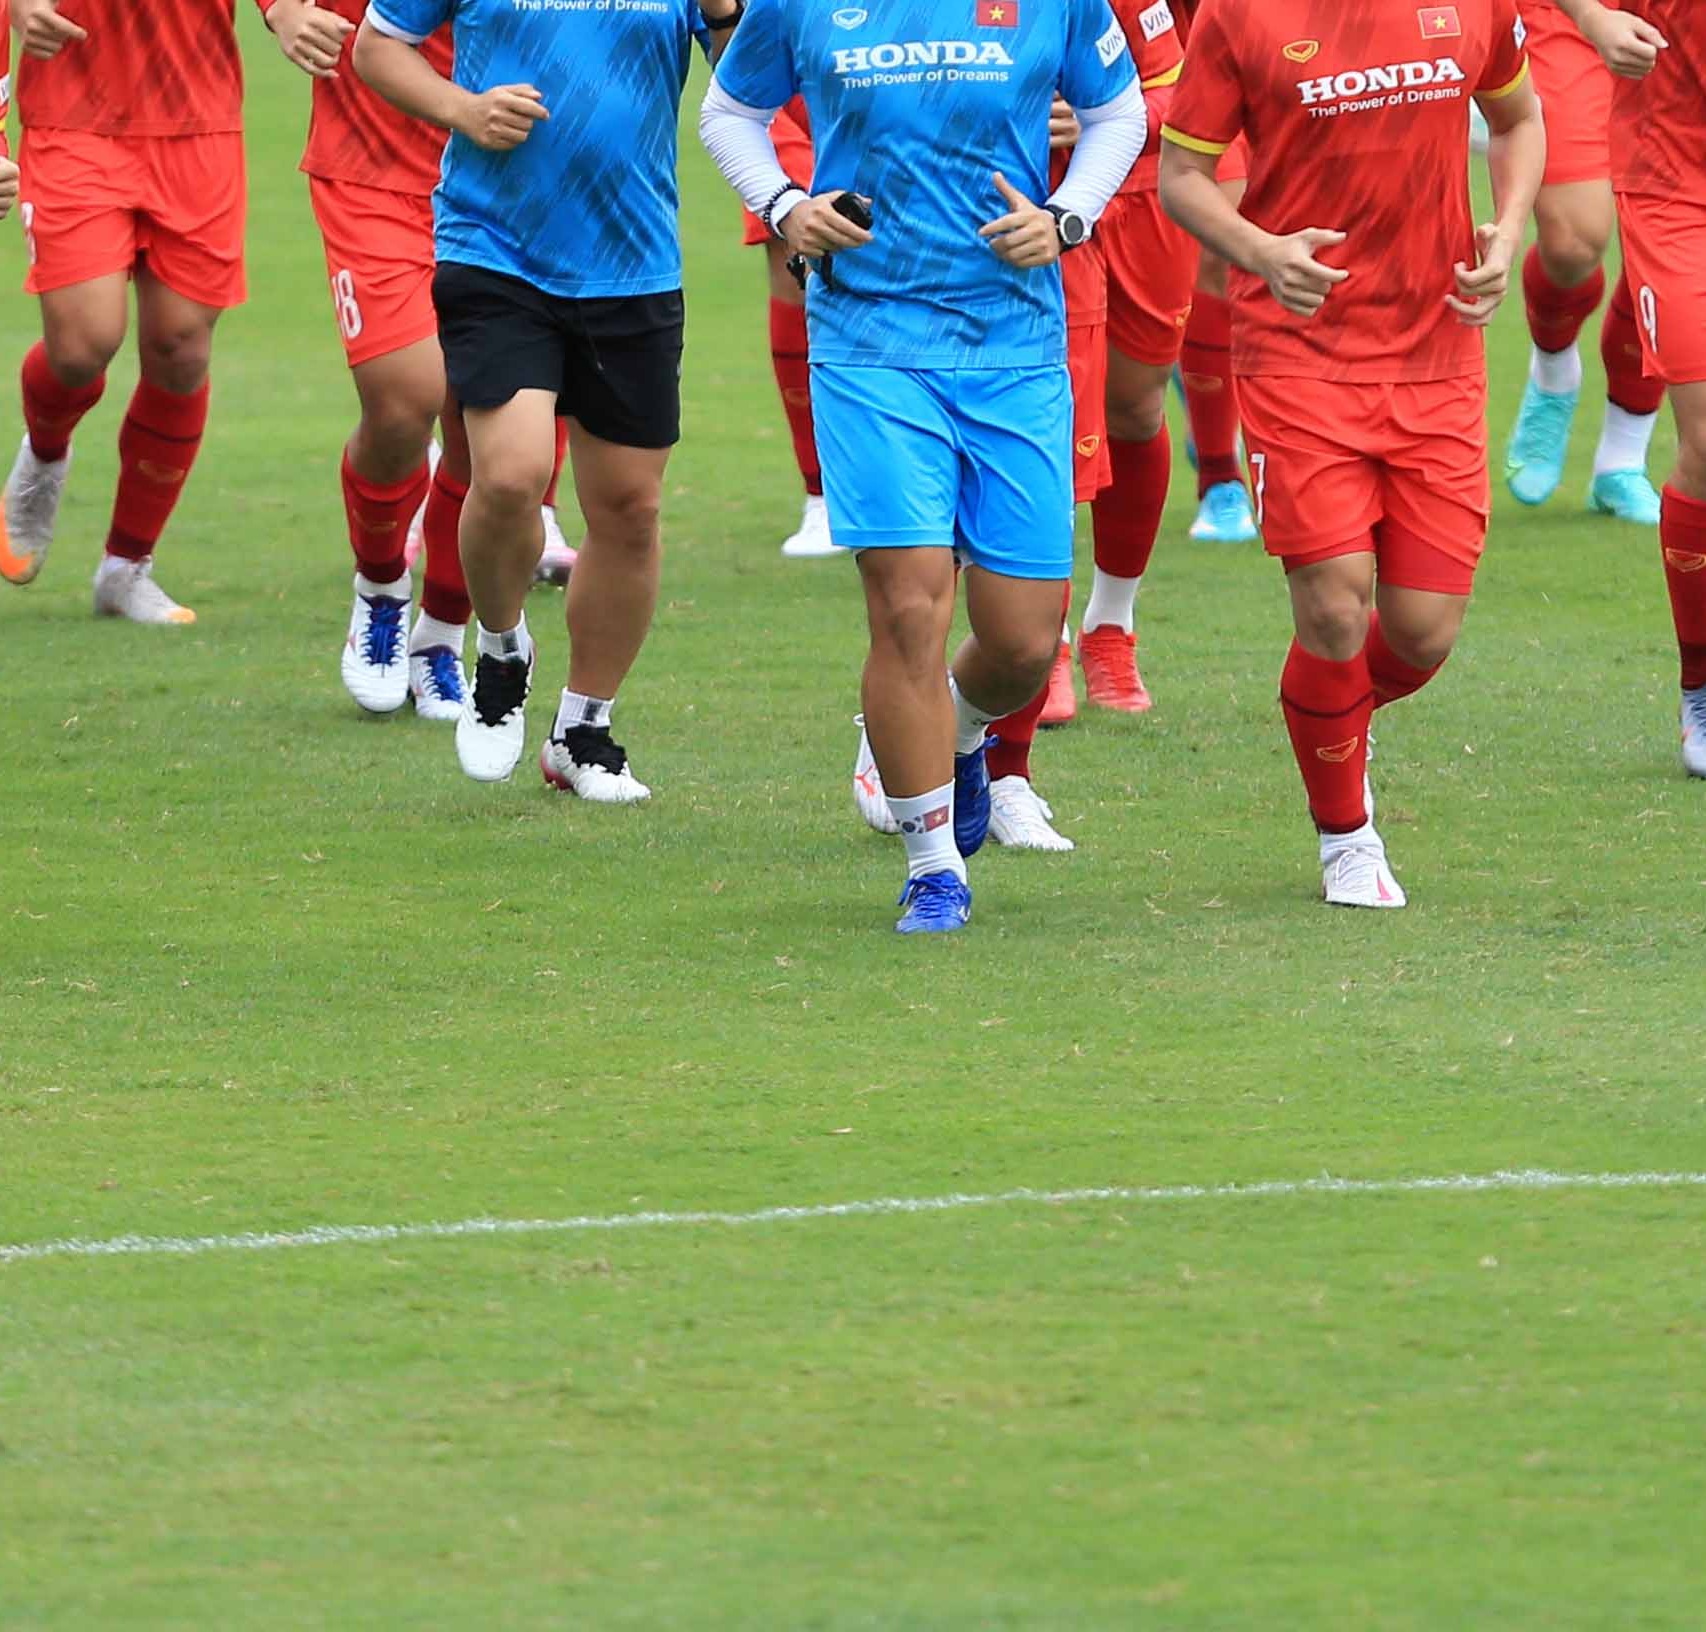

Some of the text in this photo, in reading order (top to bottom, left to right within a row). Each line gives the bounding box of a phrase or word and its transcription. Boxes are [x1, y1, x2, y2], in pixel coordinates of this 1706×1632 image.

[832, 41, 1014, 73] HONDA
[842, 69, 1009, 89] The Power of Dreams
[1297, 58, 1465, 105] HONDA
[1309, 86, 1462, 119] The Power of Dreams
